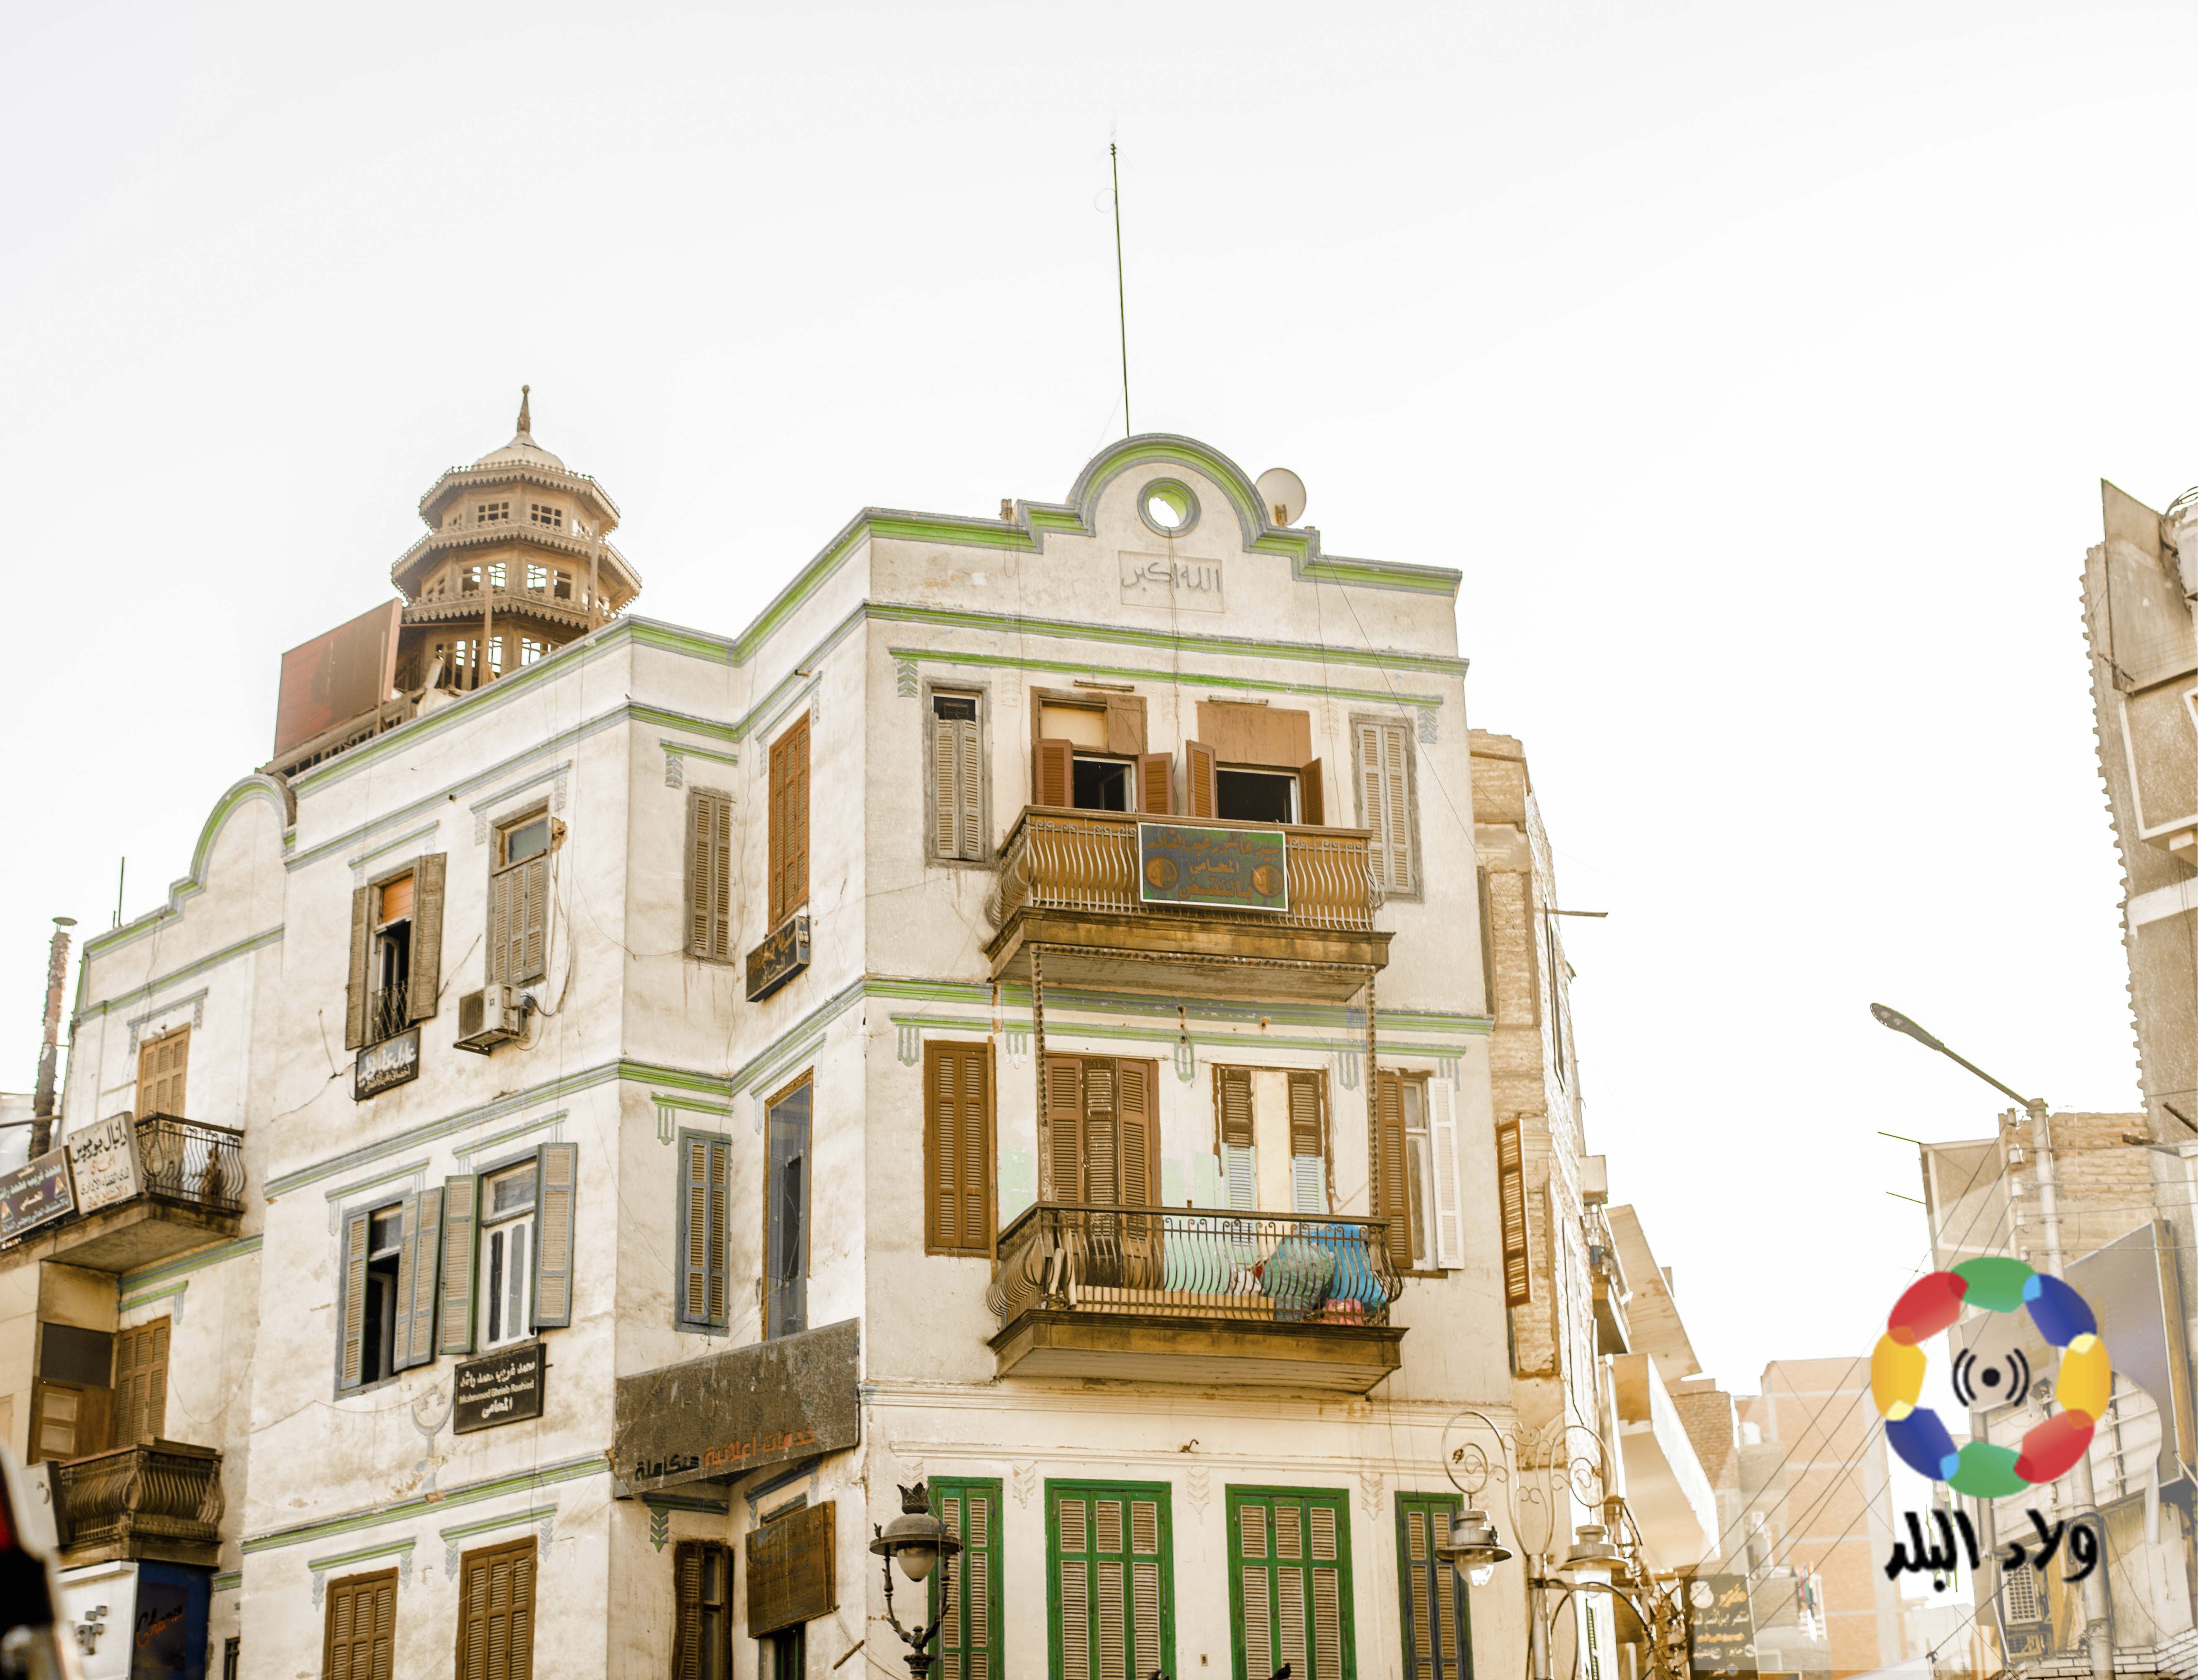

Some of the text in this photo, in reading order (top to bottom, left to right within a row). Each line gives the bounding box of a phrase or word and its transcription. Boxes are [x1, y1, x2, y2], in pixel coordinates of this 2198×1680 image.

[1181, 565, 1220, 593] الله
[1178, 876, 1253, 906] بالنقض
[761, 1422, 815, 1454] خدمات
[635, 1453, 700, 1481] متكاملة
